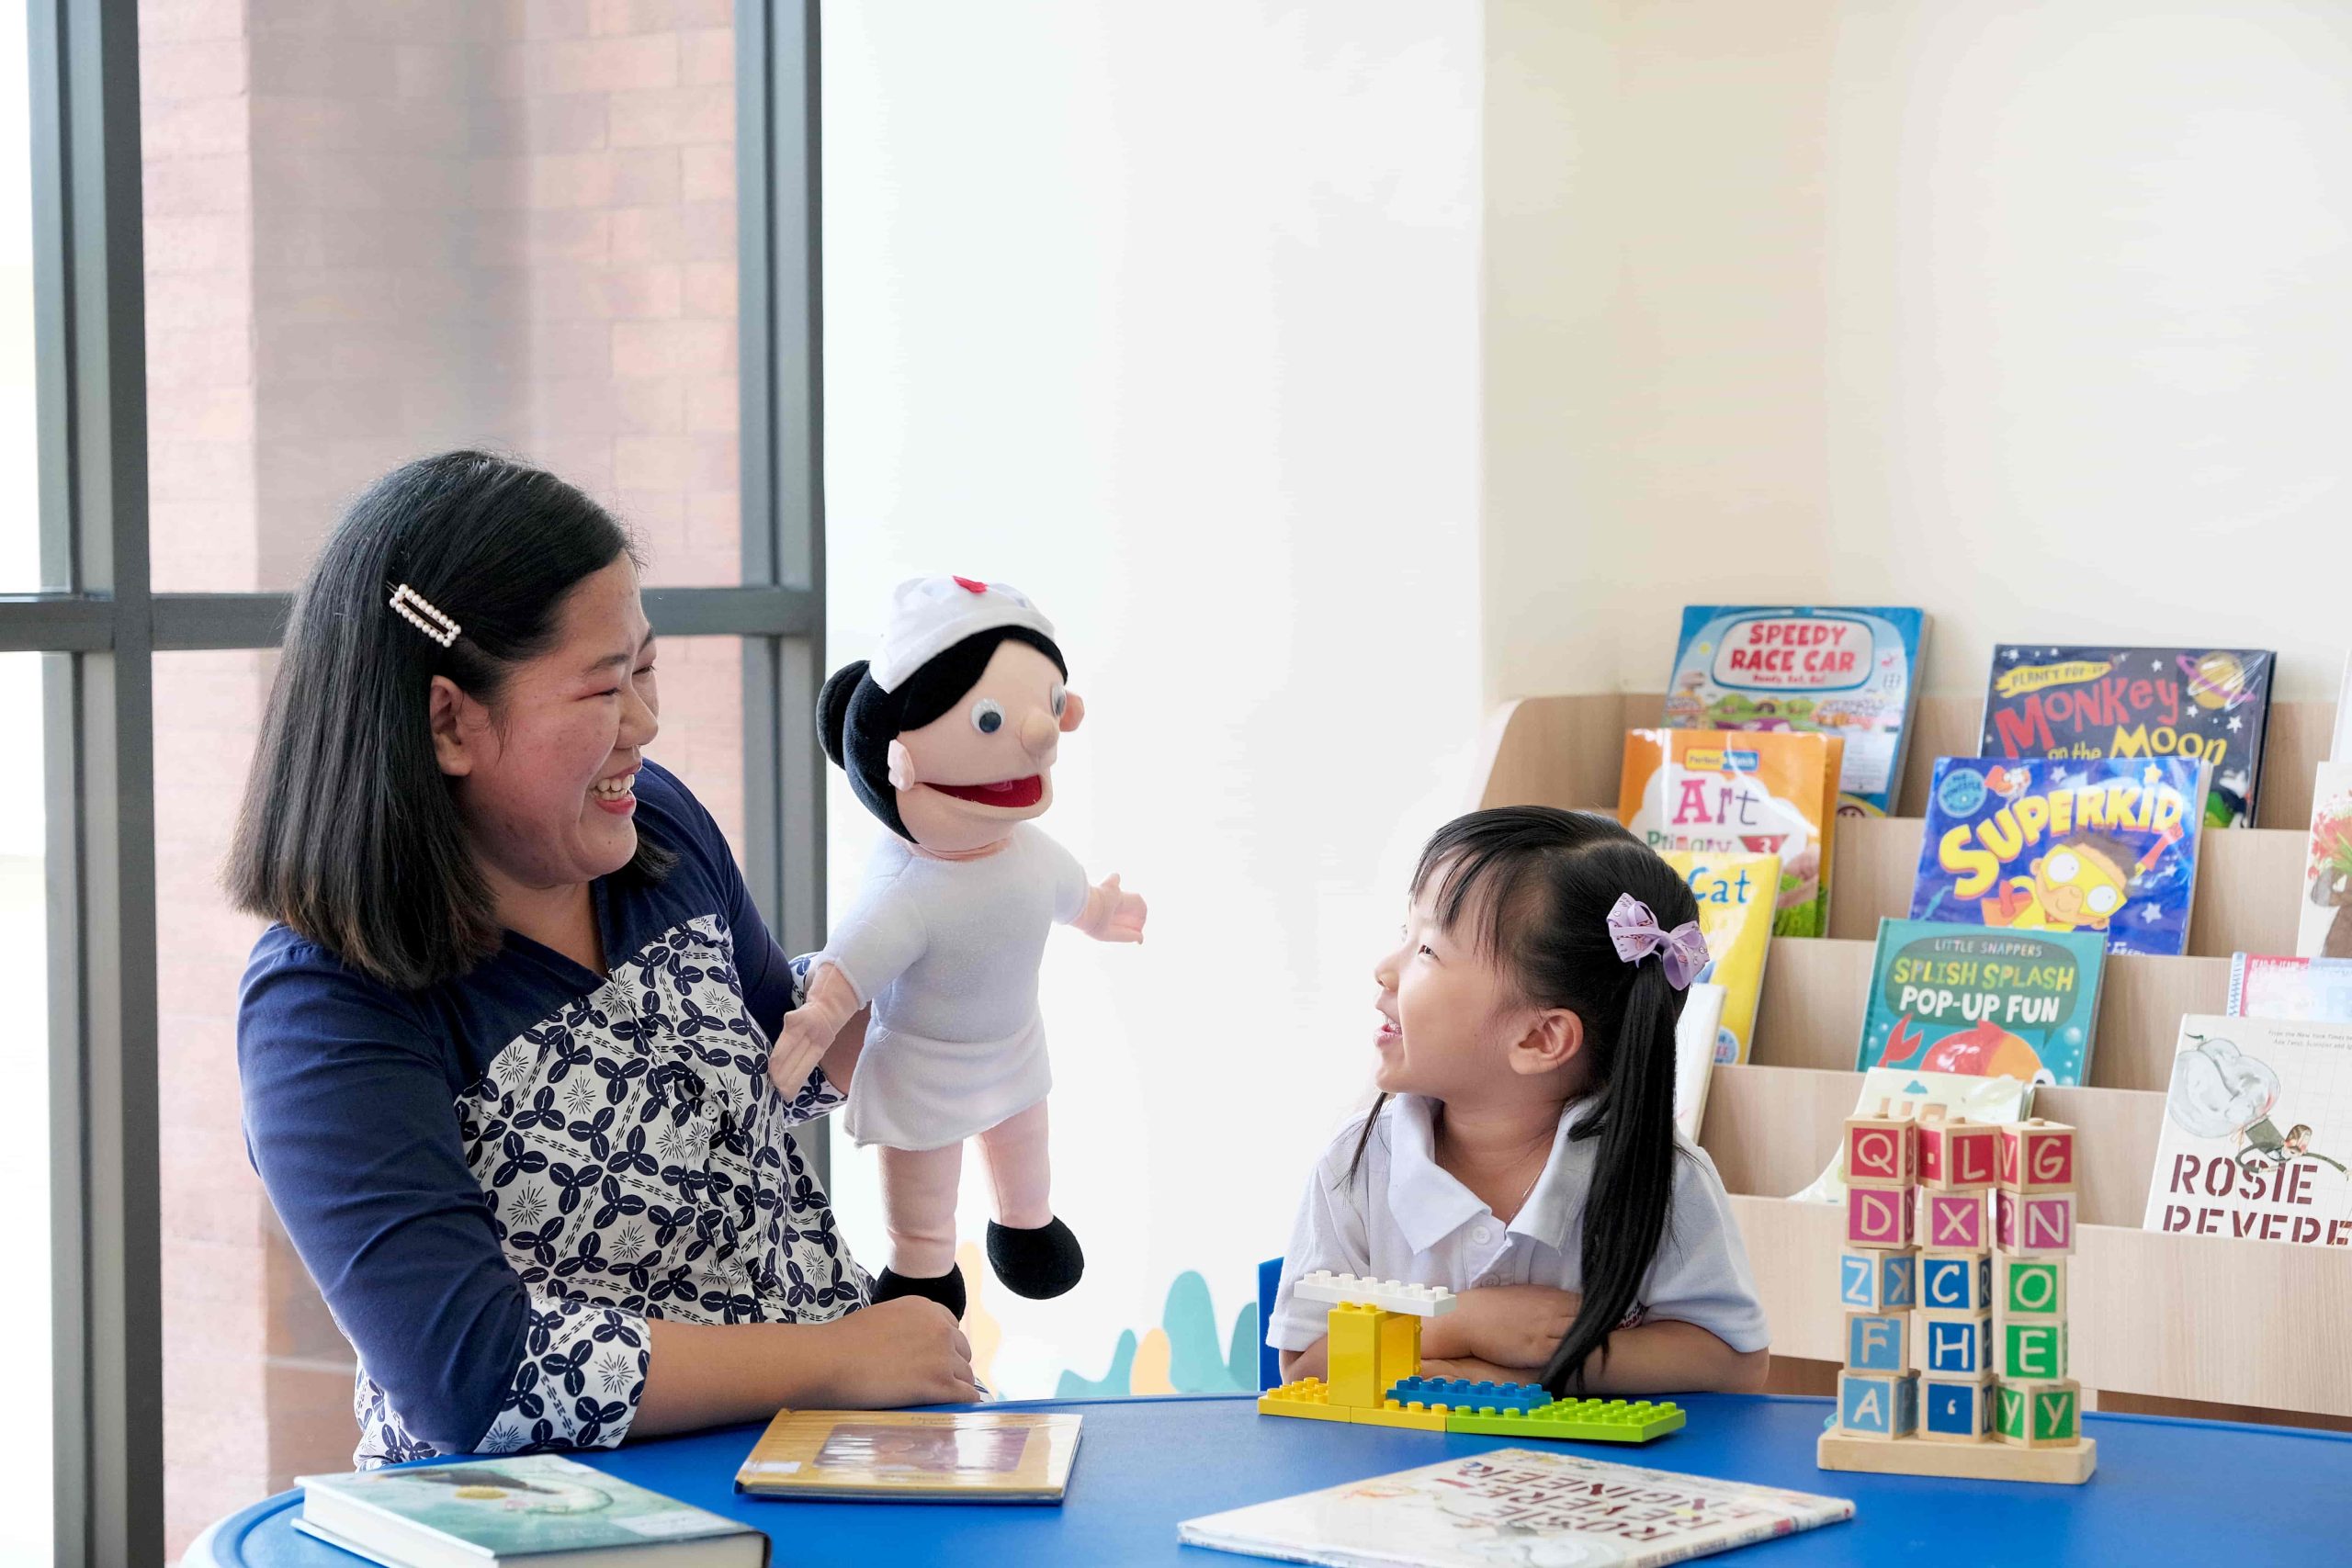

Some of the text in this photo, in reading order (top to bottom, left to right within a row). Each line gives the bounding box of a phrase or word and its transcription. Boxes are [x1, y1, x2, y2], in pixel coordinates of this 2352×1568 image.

[1749, 624, 1847, 645] SPEEDY
[1730, 649, 1855, 671] RACE CAR
[2072, 740, 2102, 761] the
[1671, 778, 1759, 825] Art
[1687, 866, 1751, 904] Cat
[1935, 939, 2042, 958] LITTLE SNAPPERS
[1894, 958, 2075, 992] SPLISH SPLASH
[1899, 986, 2059, 1023] POP-UP FUN
[1858, 1133, 1894, 1175] Q
[1962, 1139, 1986, 1180] L
[2033, 1137, 2065, 1180] G
[2169, 1154, 2319, 1205] ROSIE
[1860, 1193, 1893, 1236] D
[1939, 1202, 1973, 1242] X
[2029, 1203, 2064, 1246] N
[1846, 1259, 1869, 1303] Z
[1932, 1264, 1960, 1303] C
[2015, 1269, 2053, 1308] O
[1861, 1322, 1889, 1364] F
[1935, 1326, 1969, 1369] H
[2019, 1330, 2048, 1373] E
[1853, 1388, 1882, 1426] A
